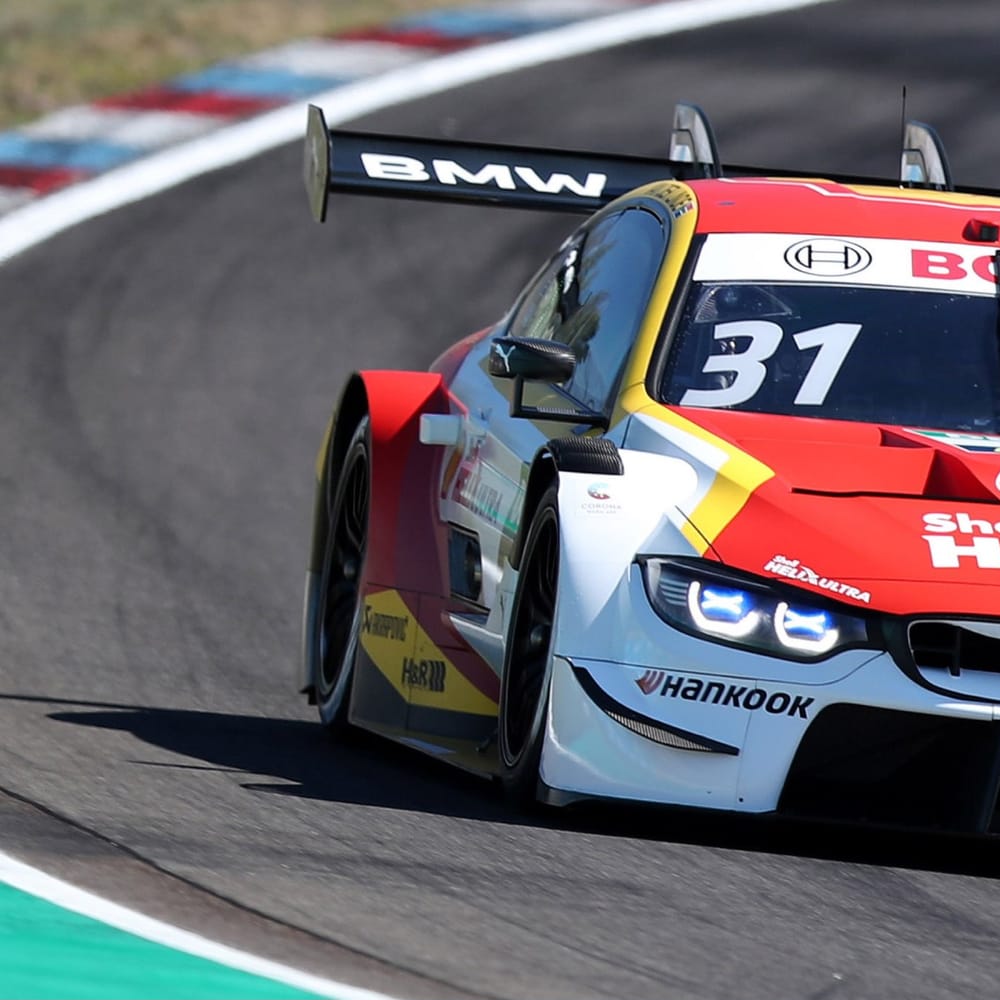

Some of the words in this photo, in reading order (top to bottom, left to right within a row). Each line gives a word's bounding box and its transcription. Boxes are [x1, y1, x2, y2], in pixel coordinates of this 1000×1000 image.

[360, 152, 607, 198] BMW
[678, 320, 863, 409] 31
[764, 560, 819, 586] HELIX
[818, 577, 871, 603] ULTRA
